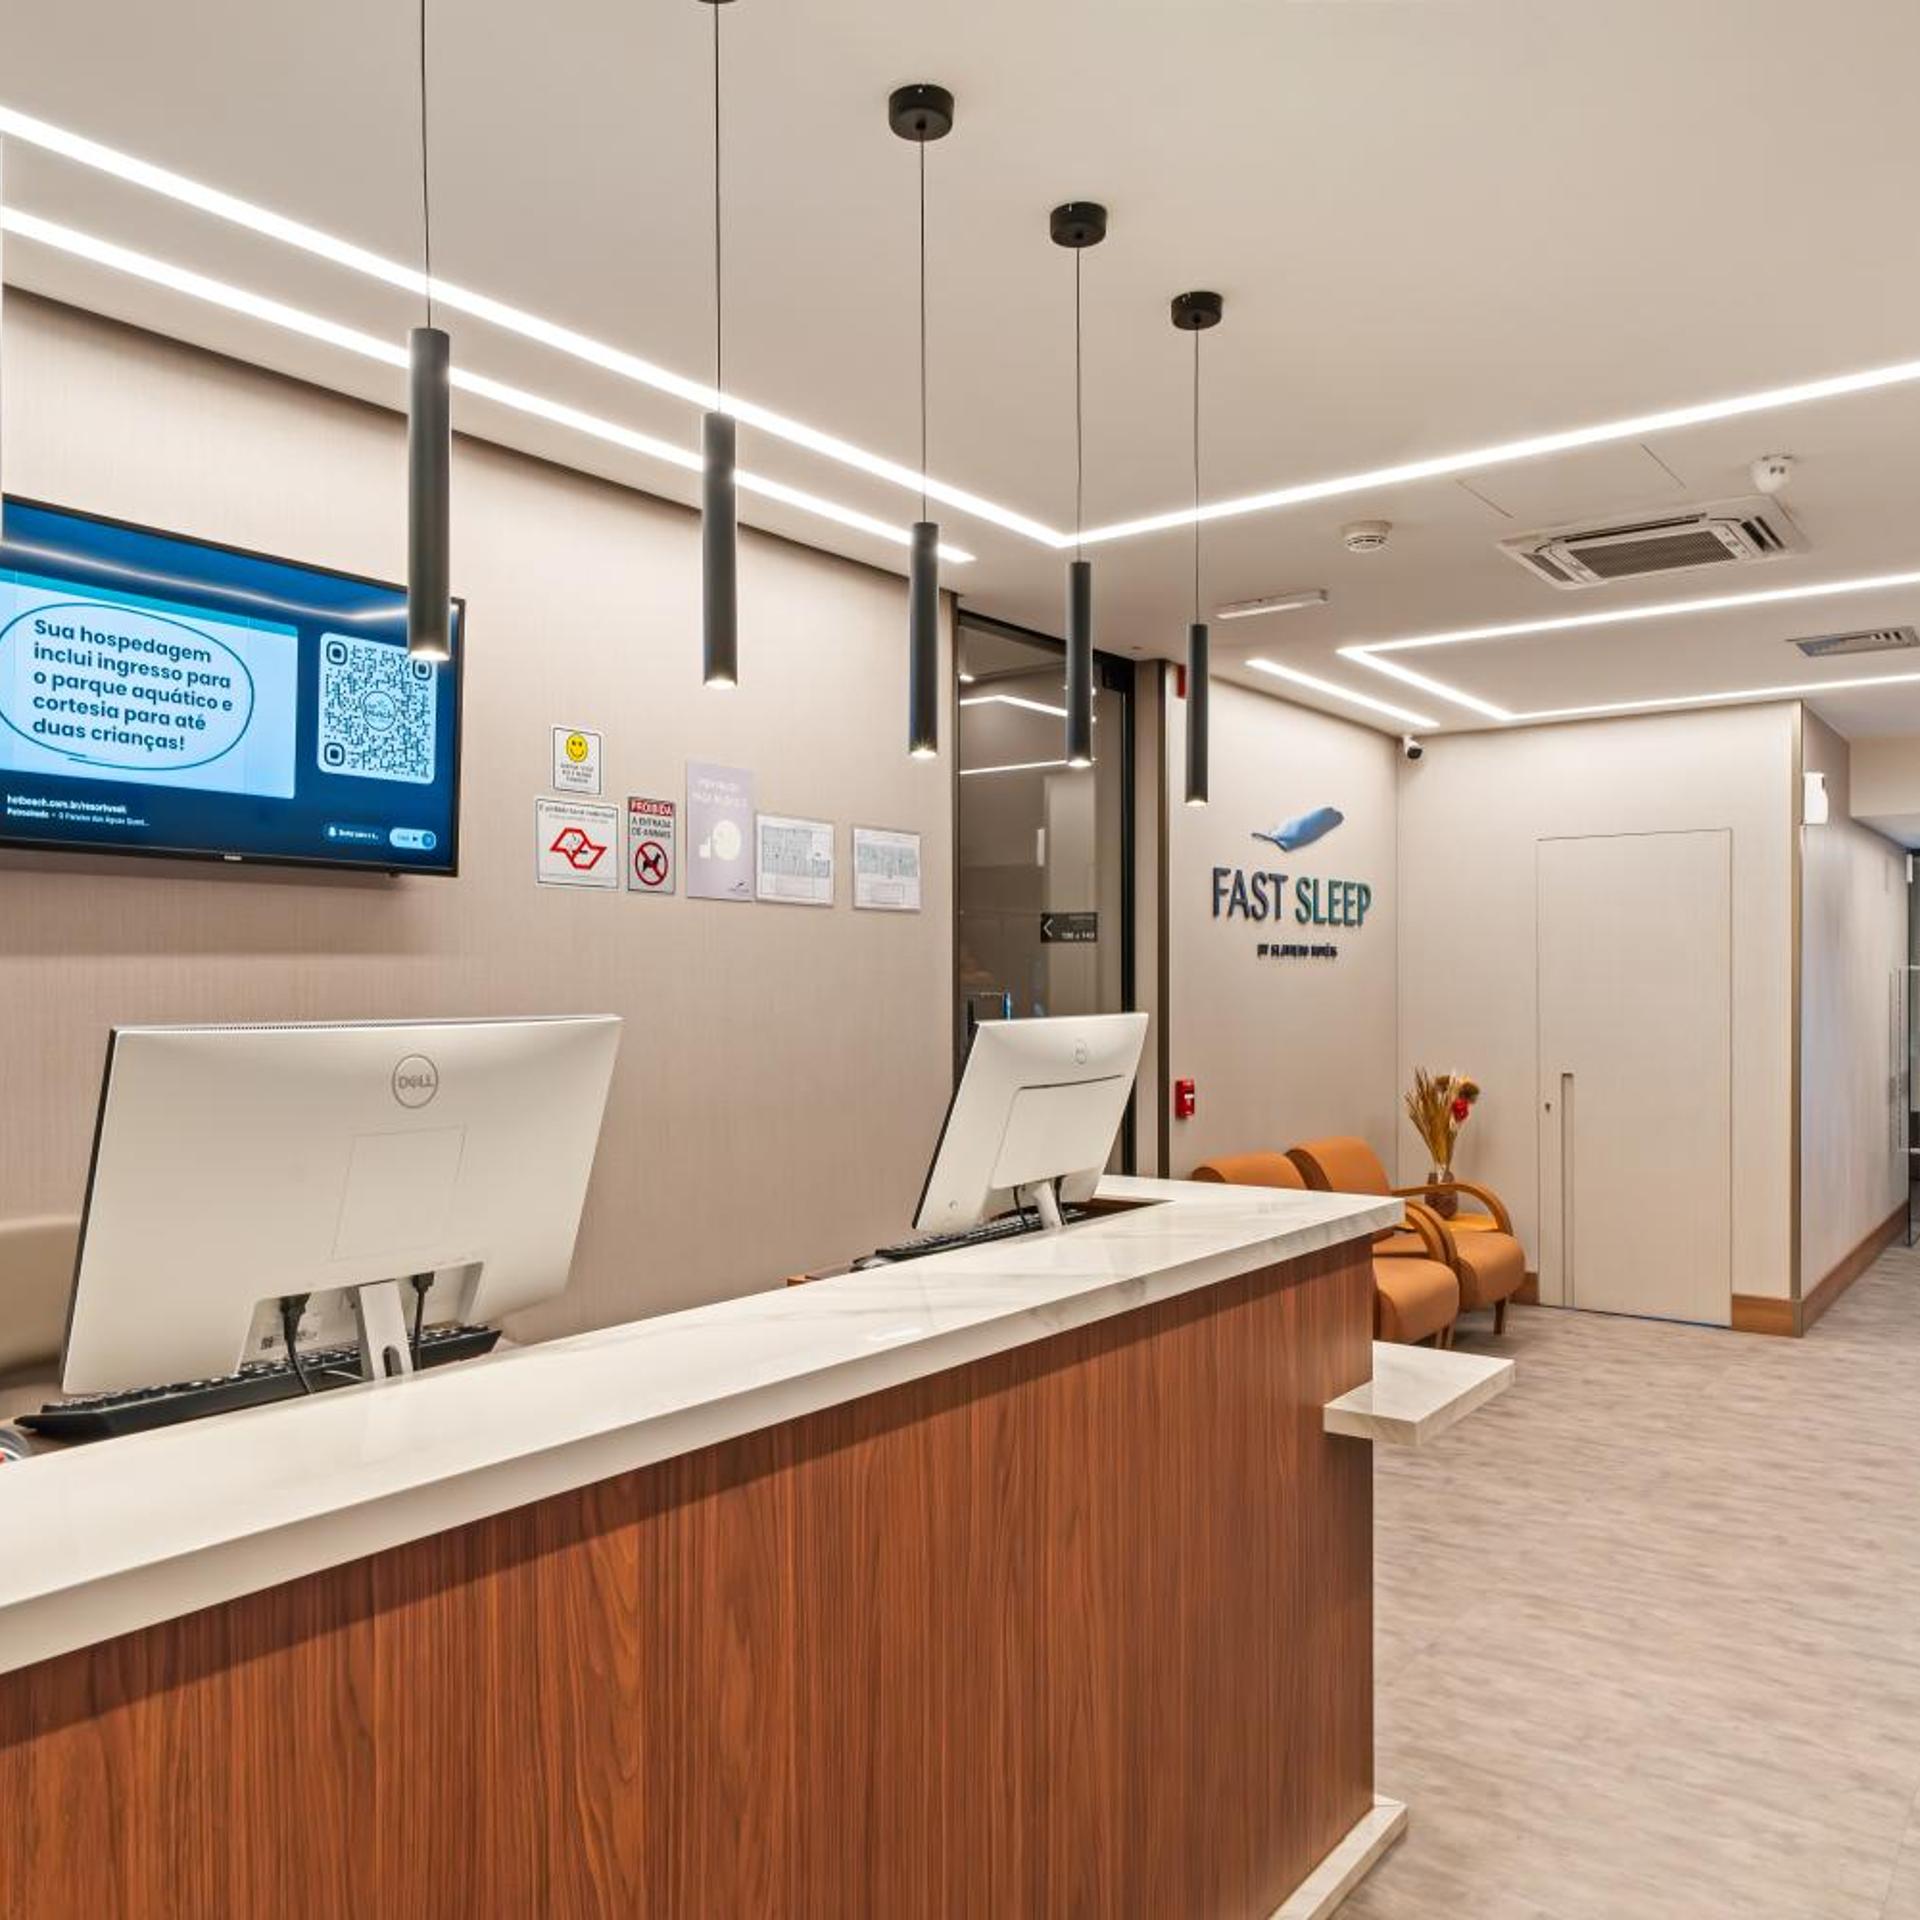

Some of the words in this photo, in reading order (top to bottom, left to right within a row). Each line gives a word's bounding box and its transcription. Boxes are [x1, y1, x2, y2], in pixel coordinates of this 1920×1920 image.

[34, 619, 75, 640] Sua
[80, 626, 212, 663] hospedagem
[33, 642, 93, 667] inclui
[97, 652, 183, 681] ingresso
[187, 671, 231, 689] para
[33, 671, 47, 685] o
[52, 674, 128, 698] parque
[131, 684, 219, 711] aquático
[222, 699, 233, 712] e
[33, 696, 120, 719] cortesia
[124, 708, 170, 726] para
[175, 713, 207, 731] até
[33, 718, 86, 739] duas
[91, 727, 186, 752] crianças!
[1212, 867, 1289, 922] FAST
[1295, 876, 1372, 927] SLEEP
